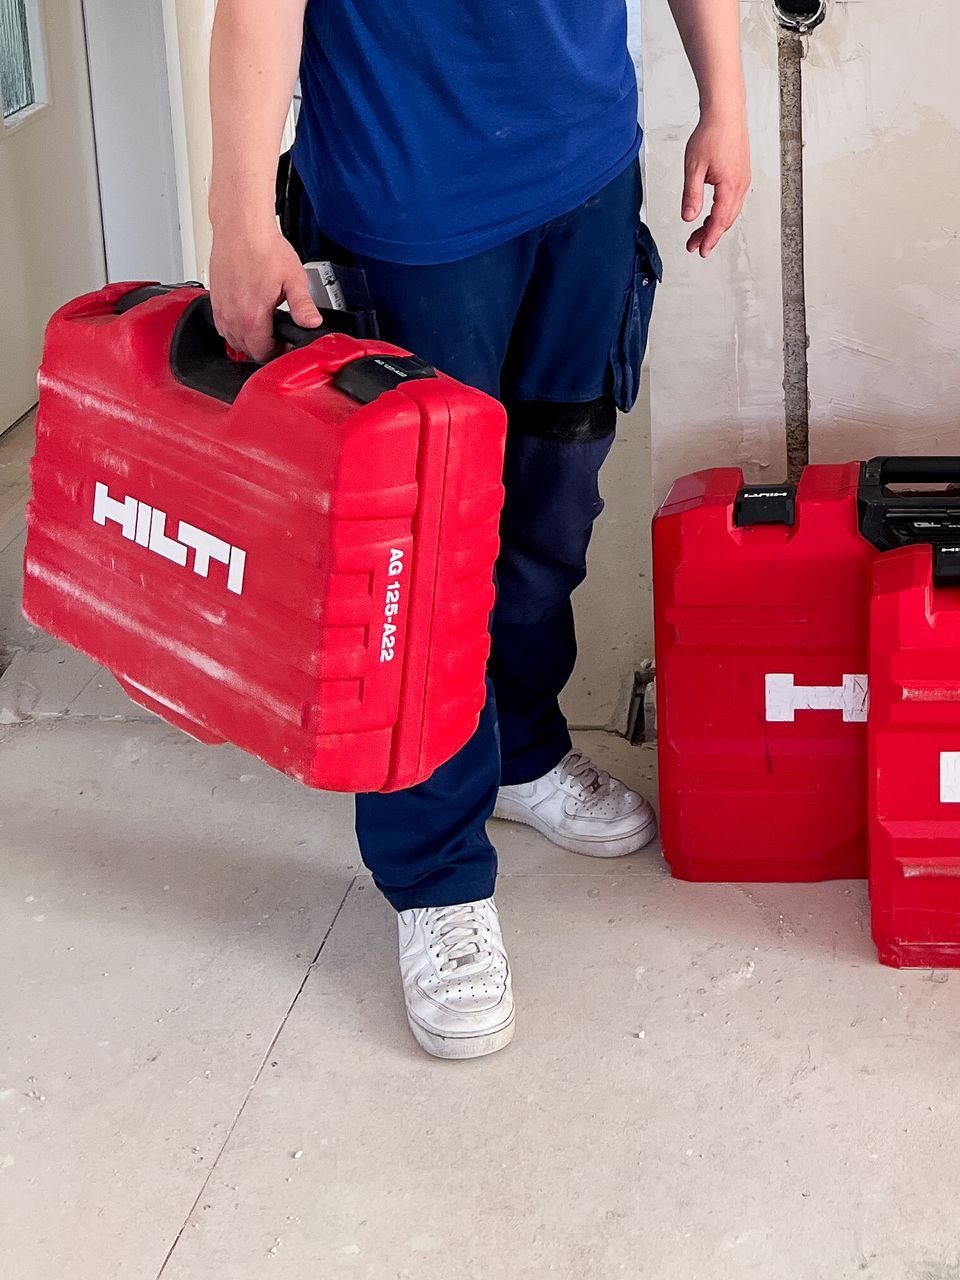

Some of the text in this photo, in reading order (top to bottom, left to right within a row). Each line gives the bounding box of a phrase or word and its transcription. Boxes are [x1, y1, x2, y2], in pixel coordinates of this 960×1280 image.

[93, 481, 247, 596] HILTI
[380, 548, 404, 663] AG 125-A22
